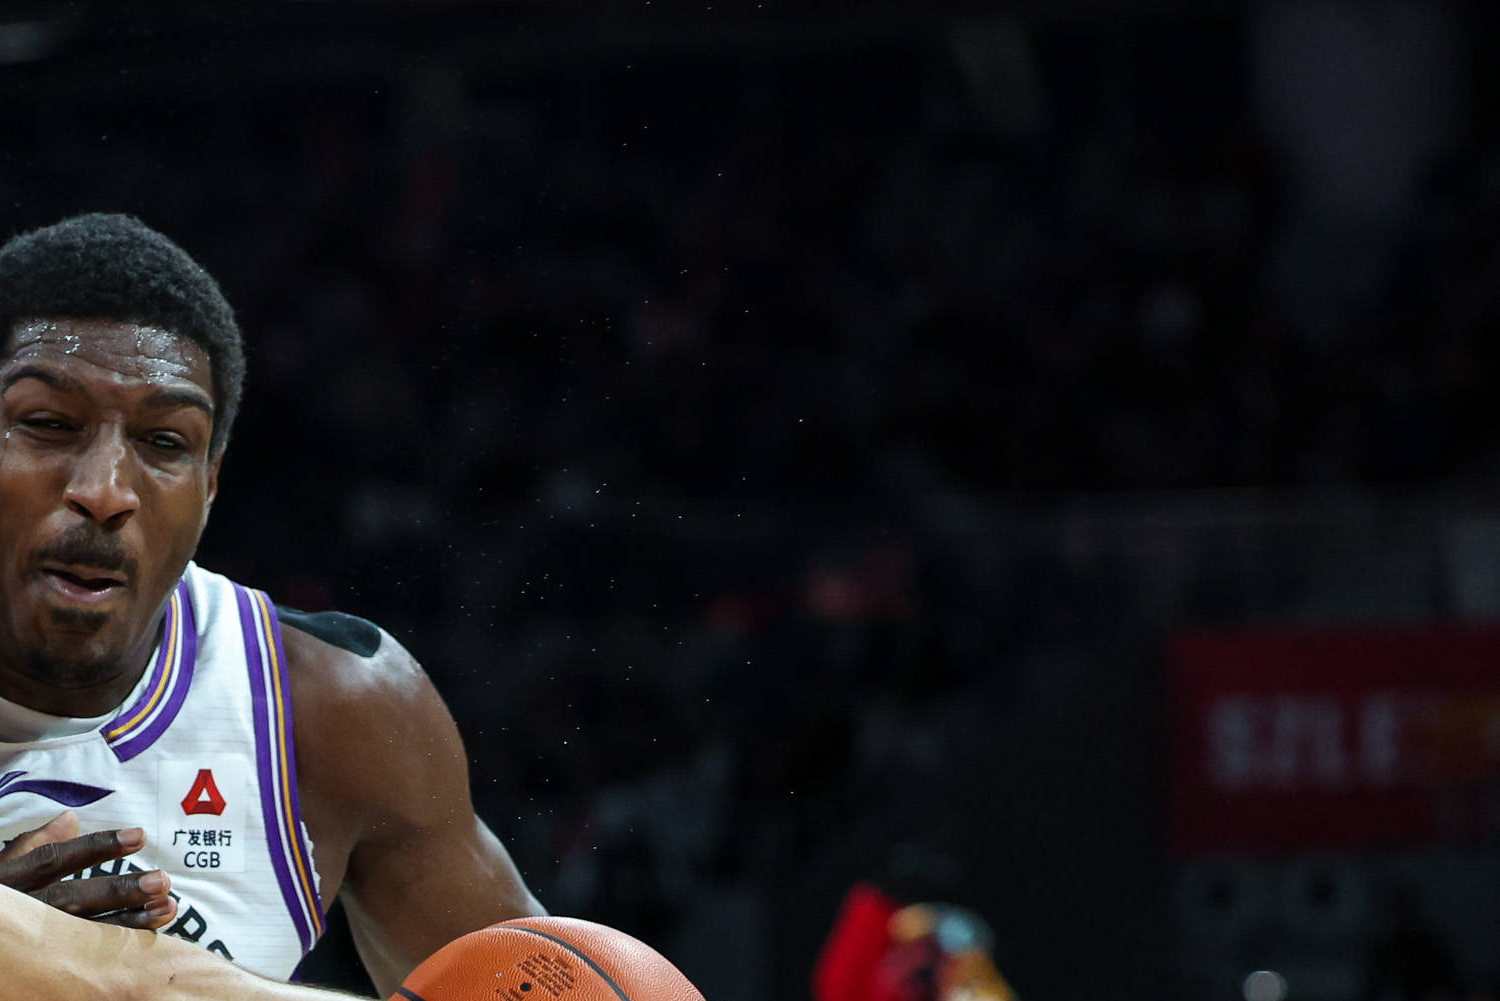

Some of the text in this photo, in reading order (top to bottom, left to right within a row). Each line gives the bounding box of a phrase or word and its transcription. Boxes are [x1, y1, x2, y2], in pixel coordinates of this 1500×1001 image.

[172, 829, 232, 846] 广发银行
[184, 851, 221, 868] CGB
